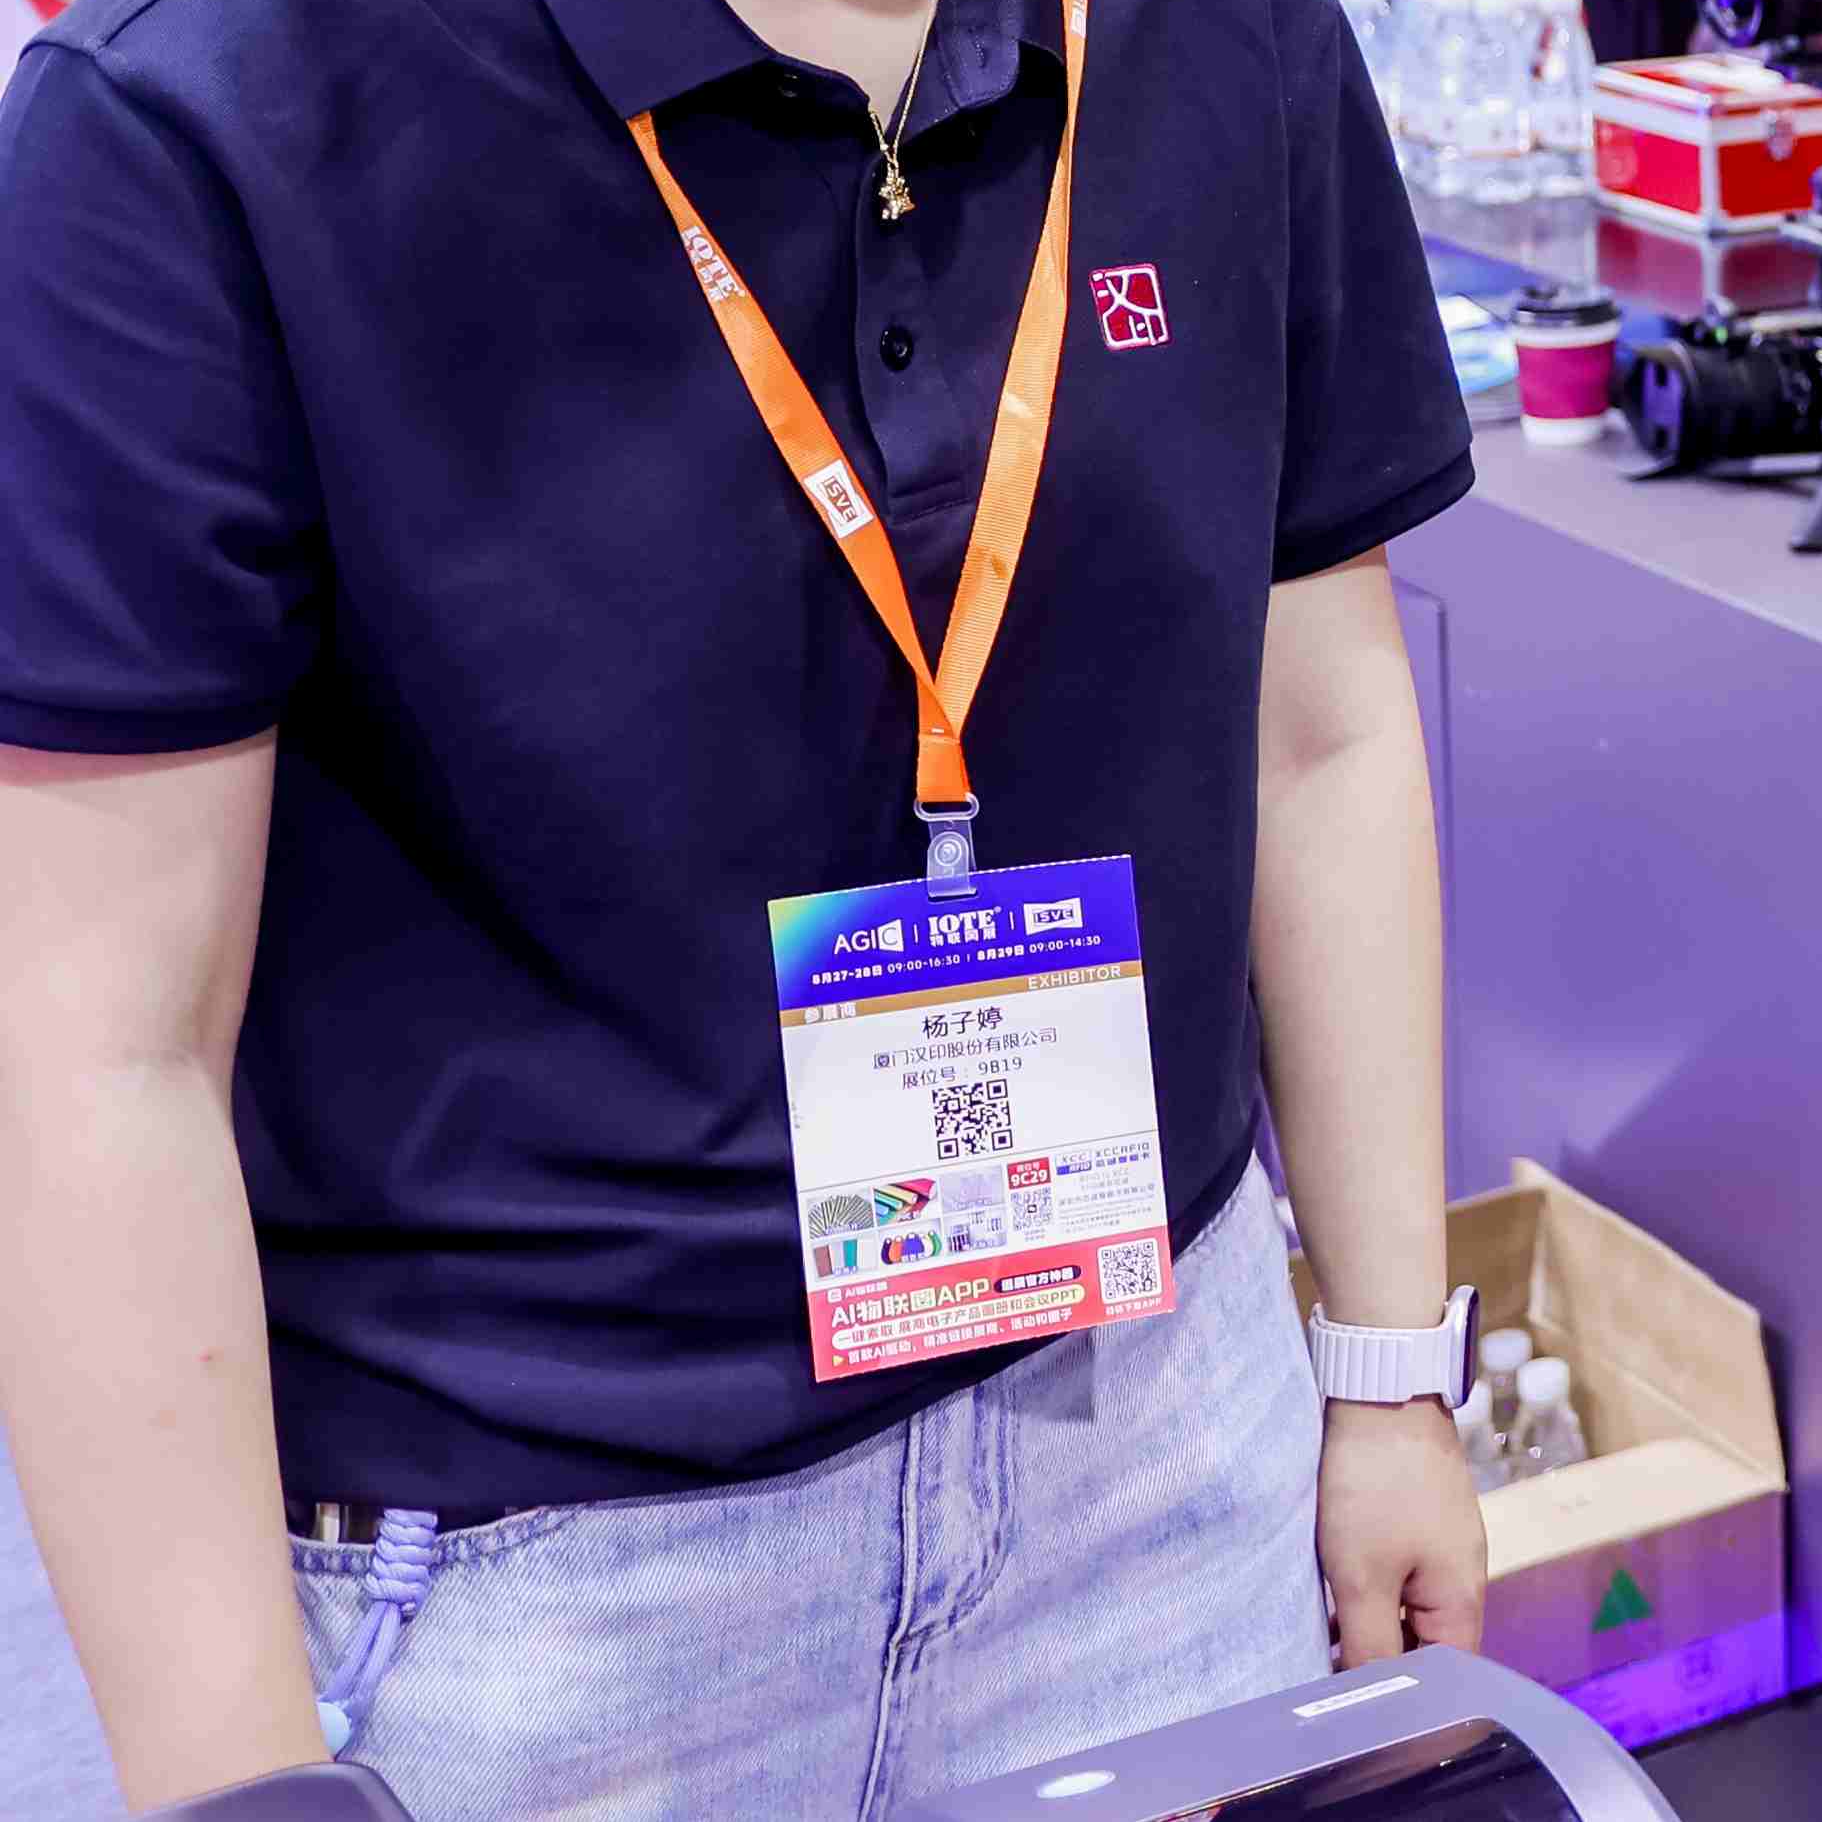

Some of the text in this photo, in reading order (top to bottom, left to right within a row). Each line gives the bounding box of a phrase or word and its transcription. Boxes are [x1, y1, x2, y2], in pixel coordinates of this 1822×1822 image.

[822, 474, 858, 524] ISVE
[833, 908, 1074, 955] AGIC IOTE ISVE
[1029, 935, 1101, 954] 09:00-14:30
[1028, 965, 1121, 990] EXHIBITOR
[921, 1006, 1004, 1040] 杨子婷
[872, 1026, 1058, 1070] 厦门汉印股份有限公司
[978, 1056, 1023, 1076] 9B19
[1010, 1169, 1049, 1188] 9C29
